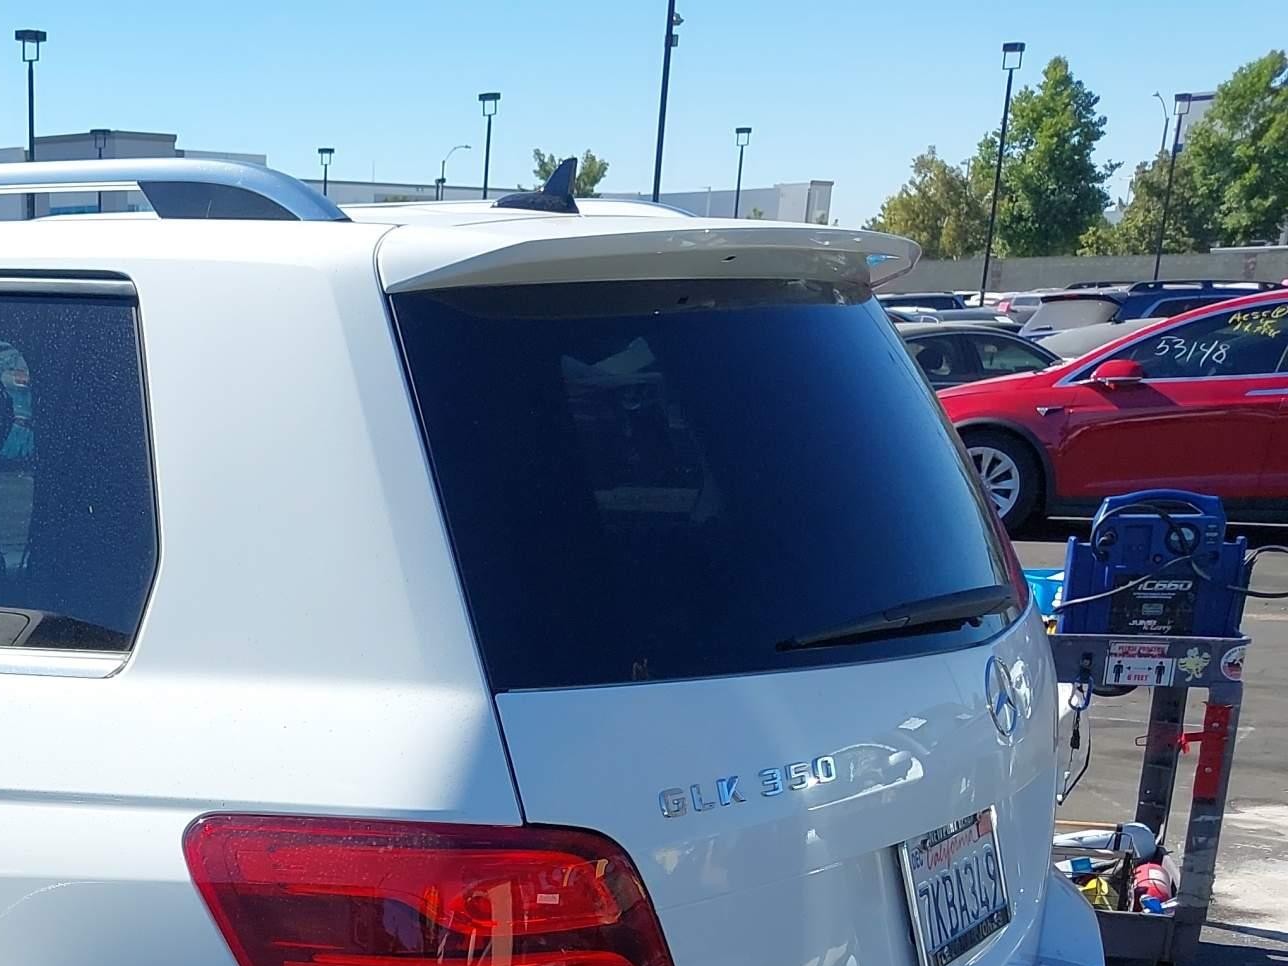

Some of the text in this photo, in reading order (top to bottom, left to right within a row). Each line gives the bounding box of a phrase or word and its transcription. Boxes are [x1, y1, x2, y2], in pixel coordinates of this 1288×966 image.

[1154, 336, 1231, 367] 53148
[659, 755, 836, 818] GLK 350
[918, 848, 998, 950] 7KBA349
